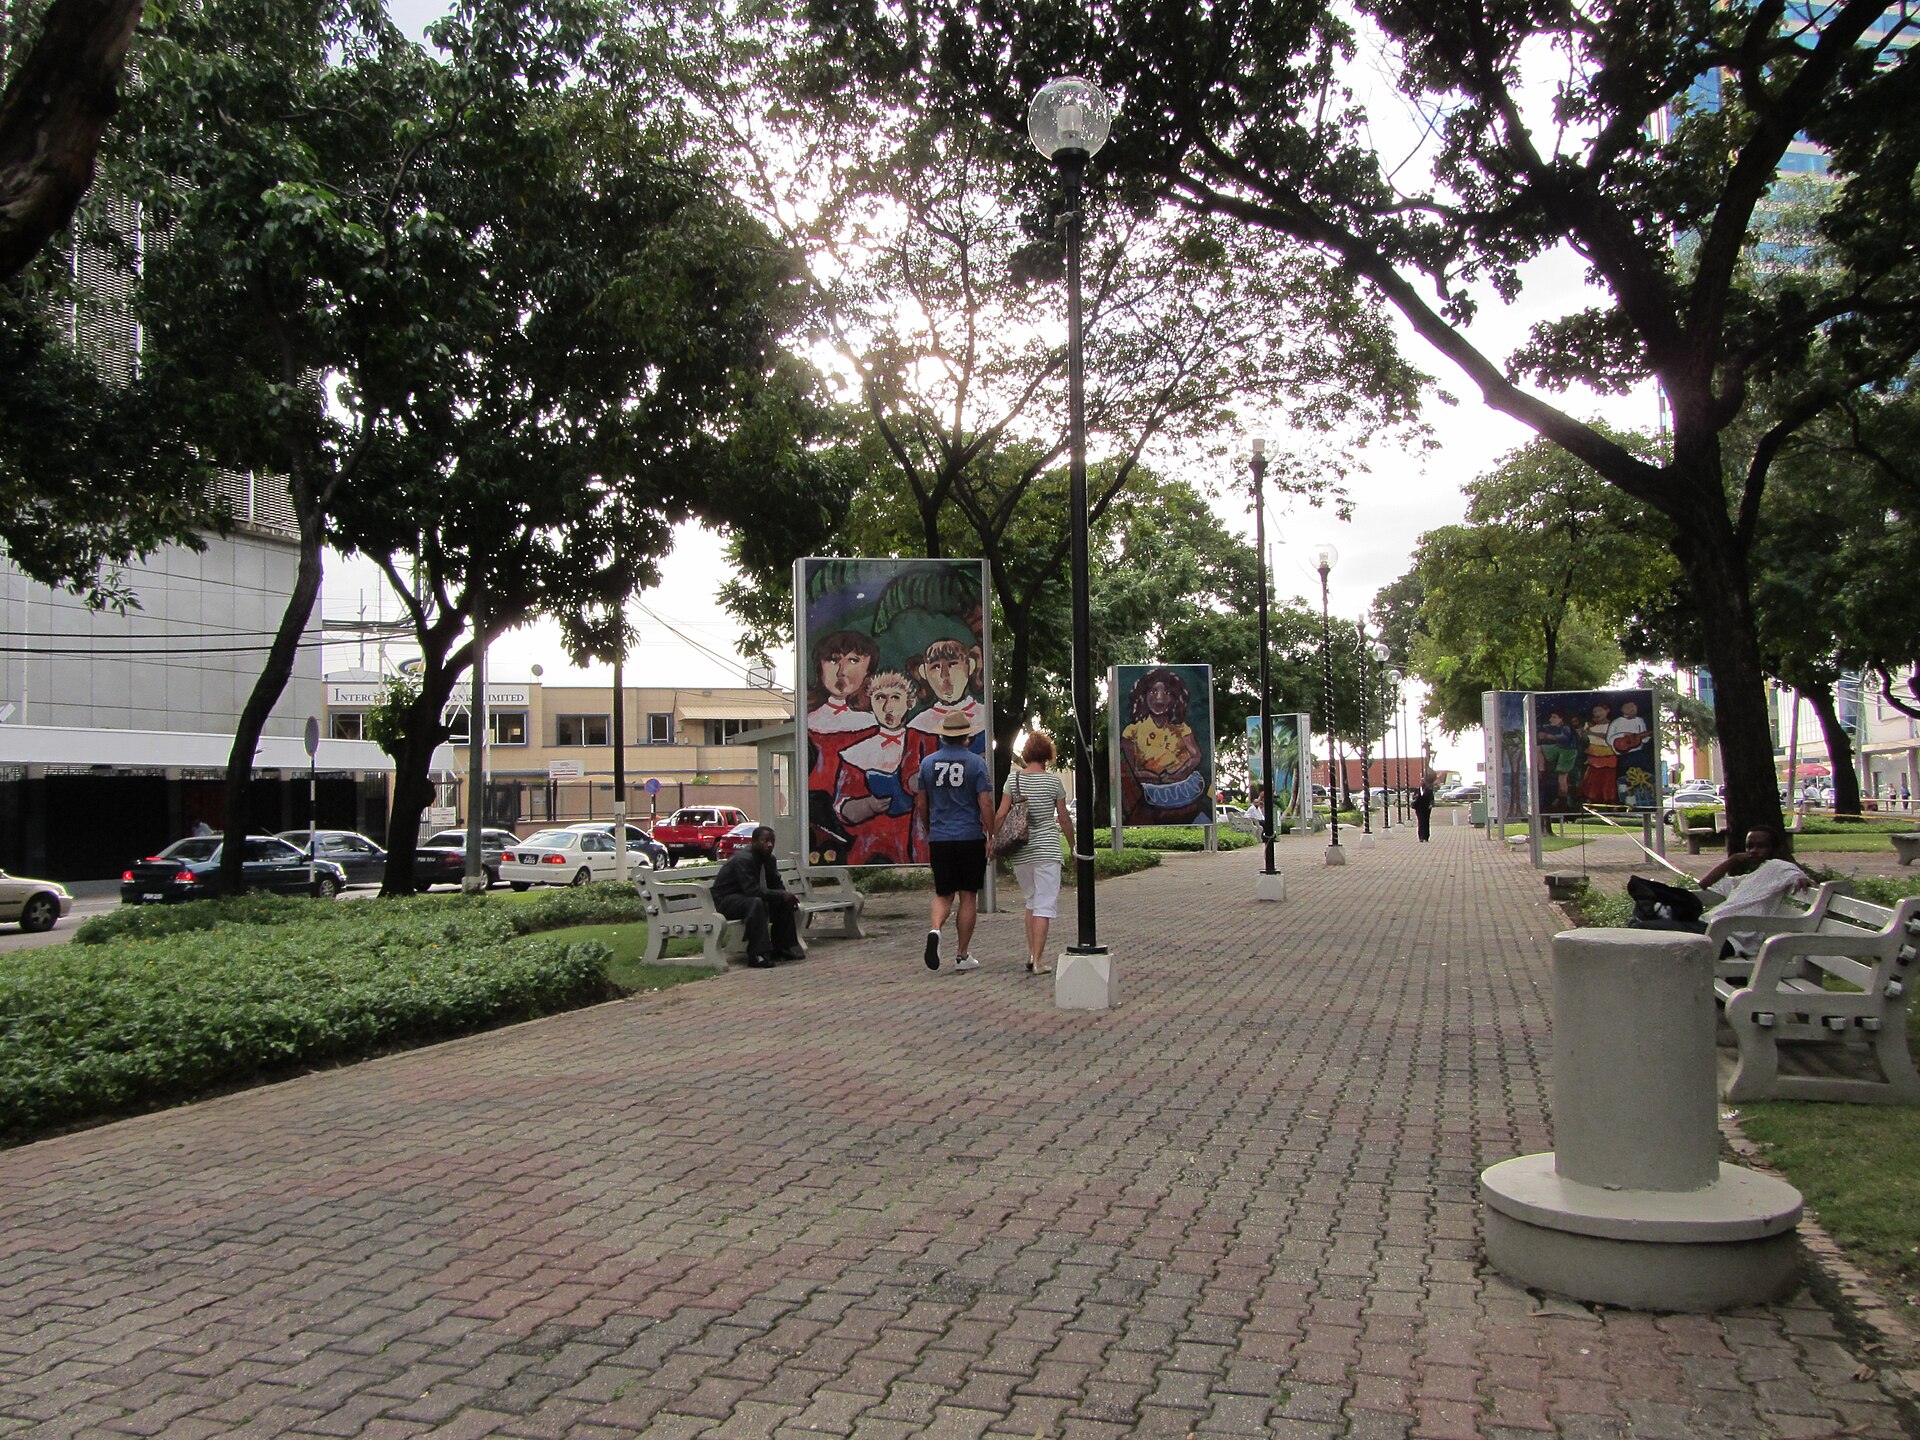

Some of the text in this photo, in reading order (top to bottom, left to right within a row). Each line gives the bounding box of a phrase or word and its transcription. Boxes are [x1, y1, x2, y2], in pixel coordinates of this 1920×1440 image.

[334, 688, 525, 702] INTERC ANK IMITED
[934, 762, 964, 787] 78
